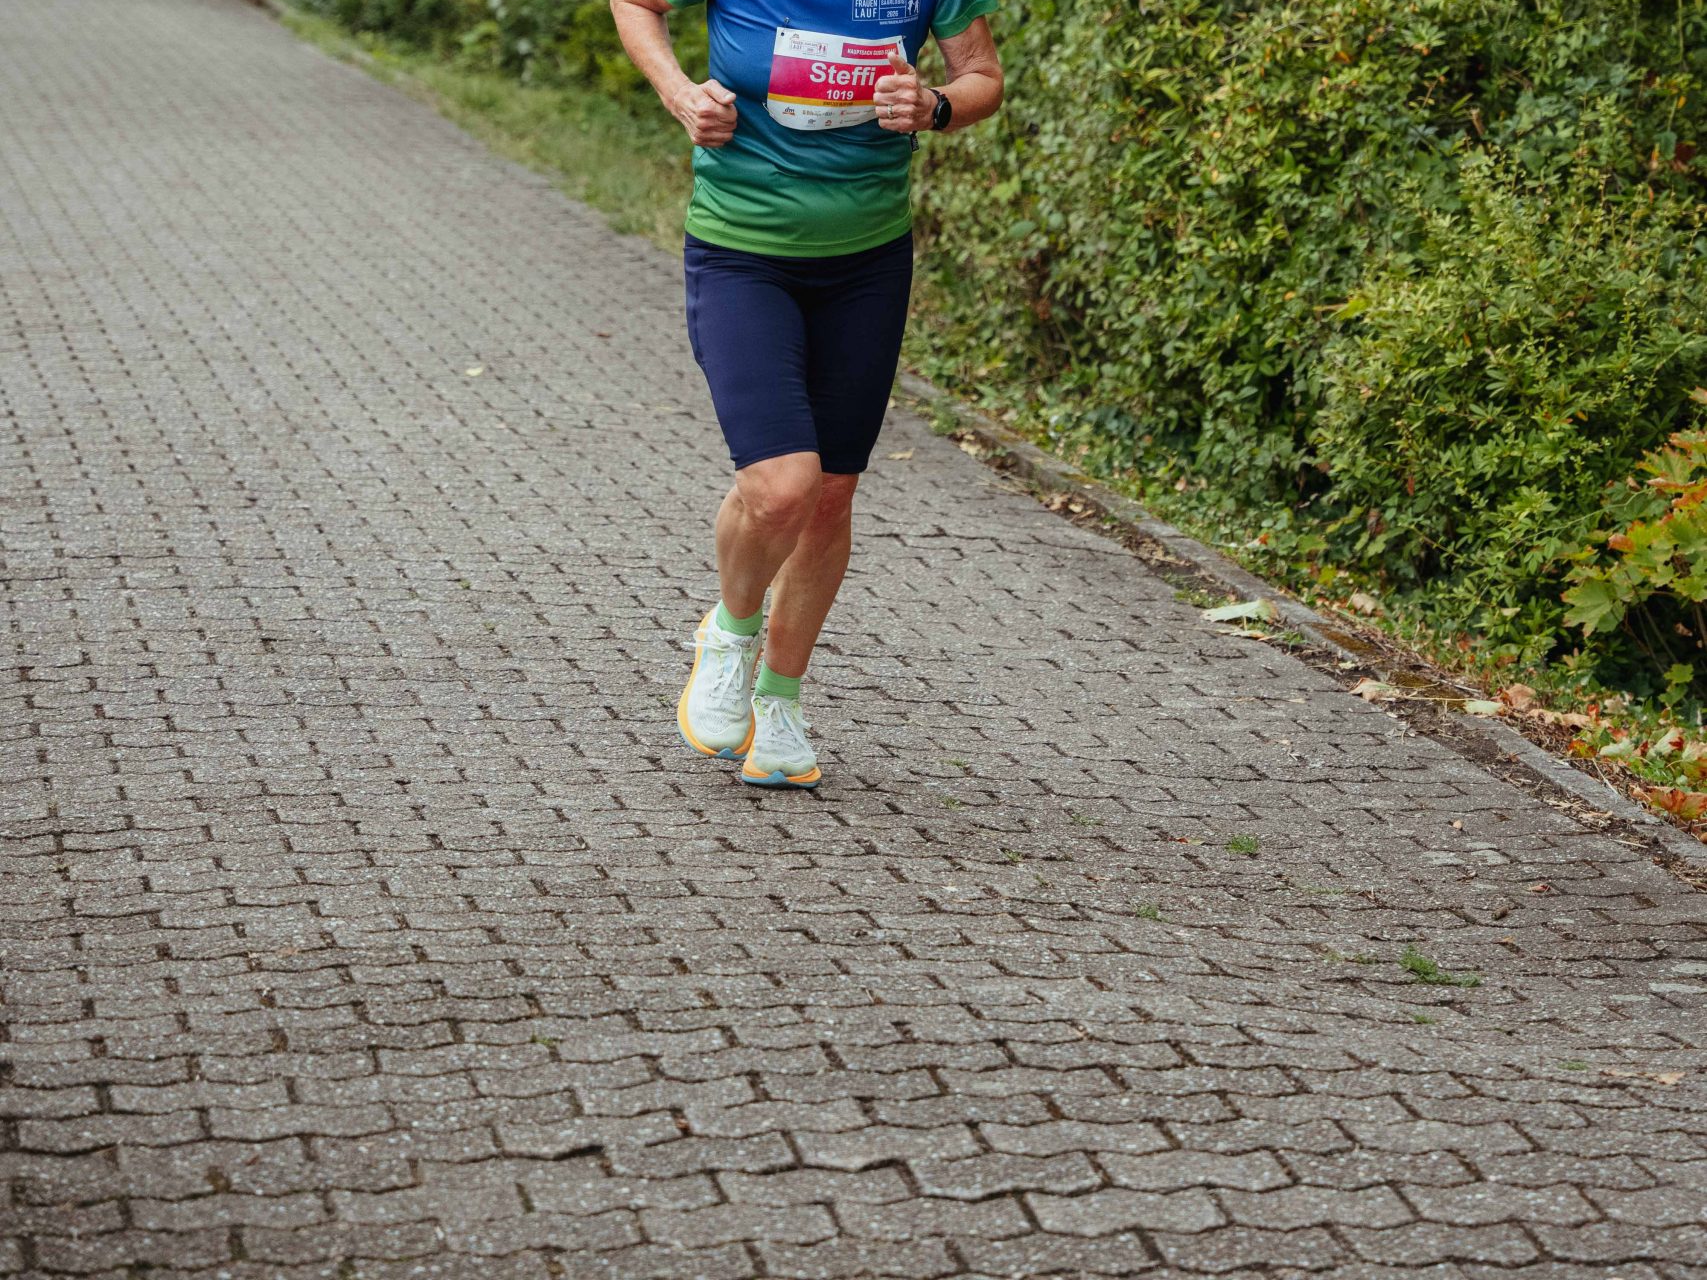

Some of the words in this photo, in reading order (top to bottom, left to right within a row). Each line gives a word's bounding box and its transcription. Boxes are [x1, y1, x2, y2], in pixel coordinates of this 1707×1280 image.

[855, 8, 877, 18] LAUF
[809, 62, 876, 86] Steffi
[826, 90, 854, 100] 1019
